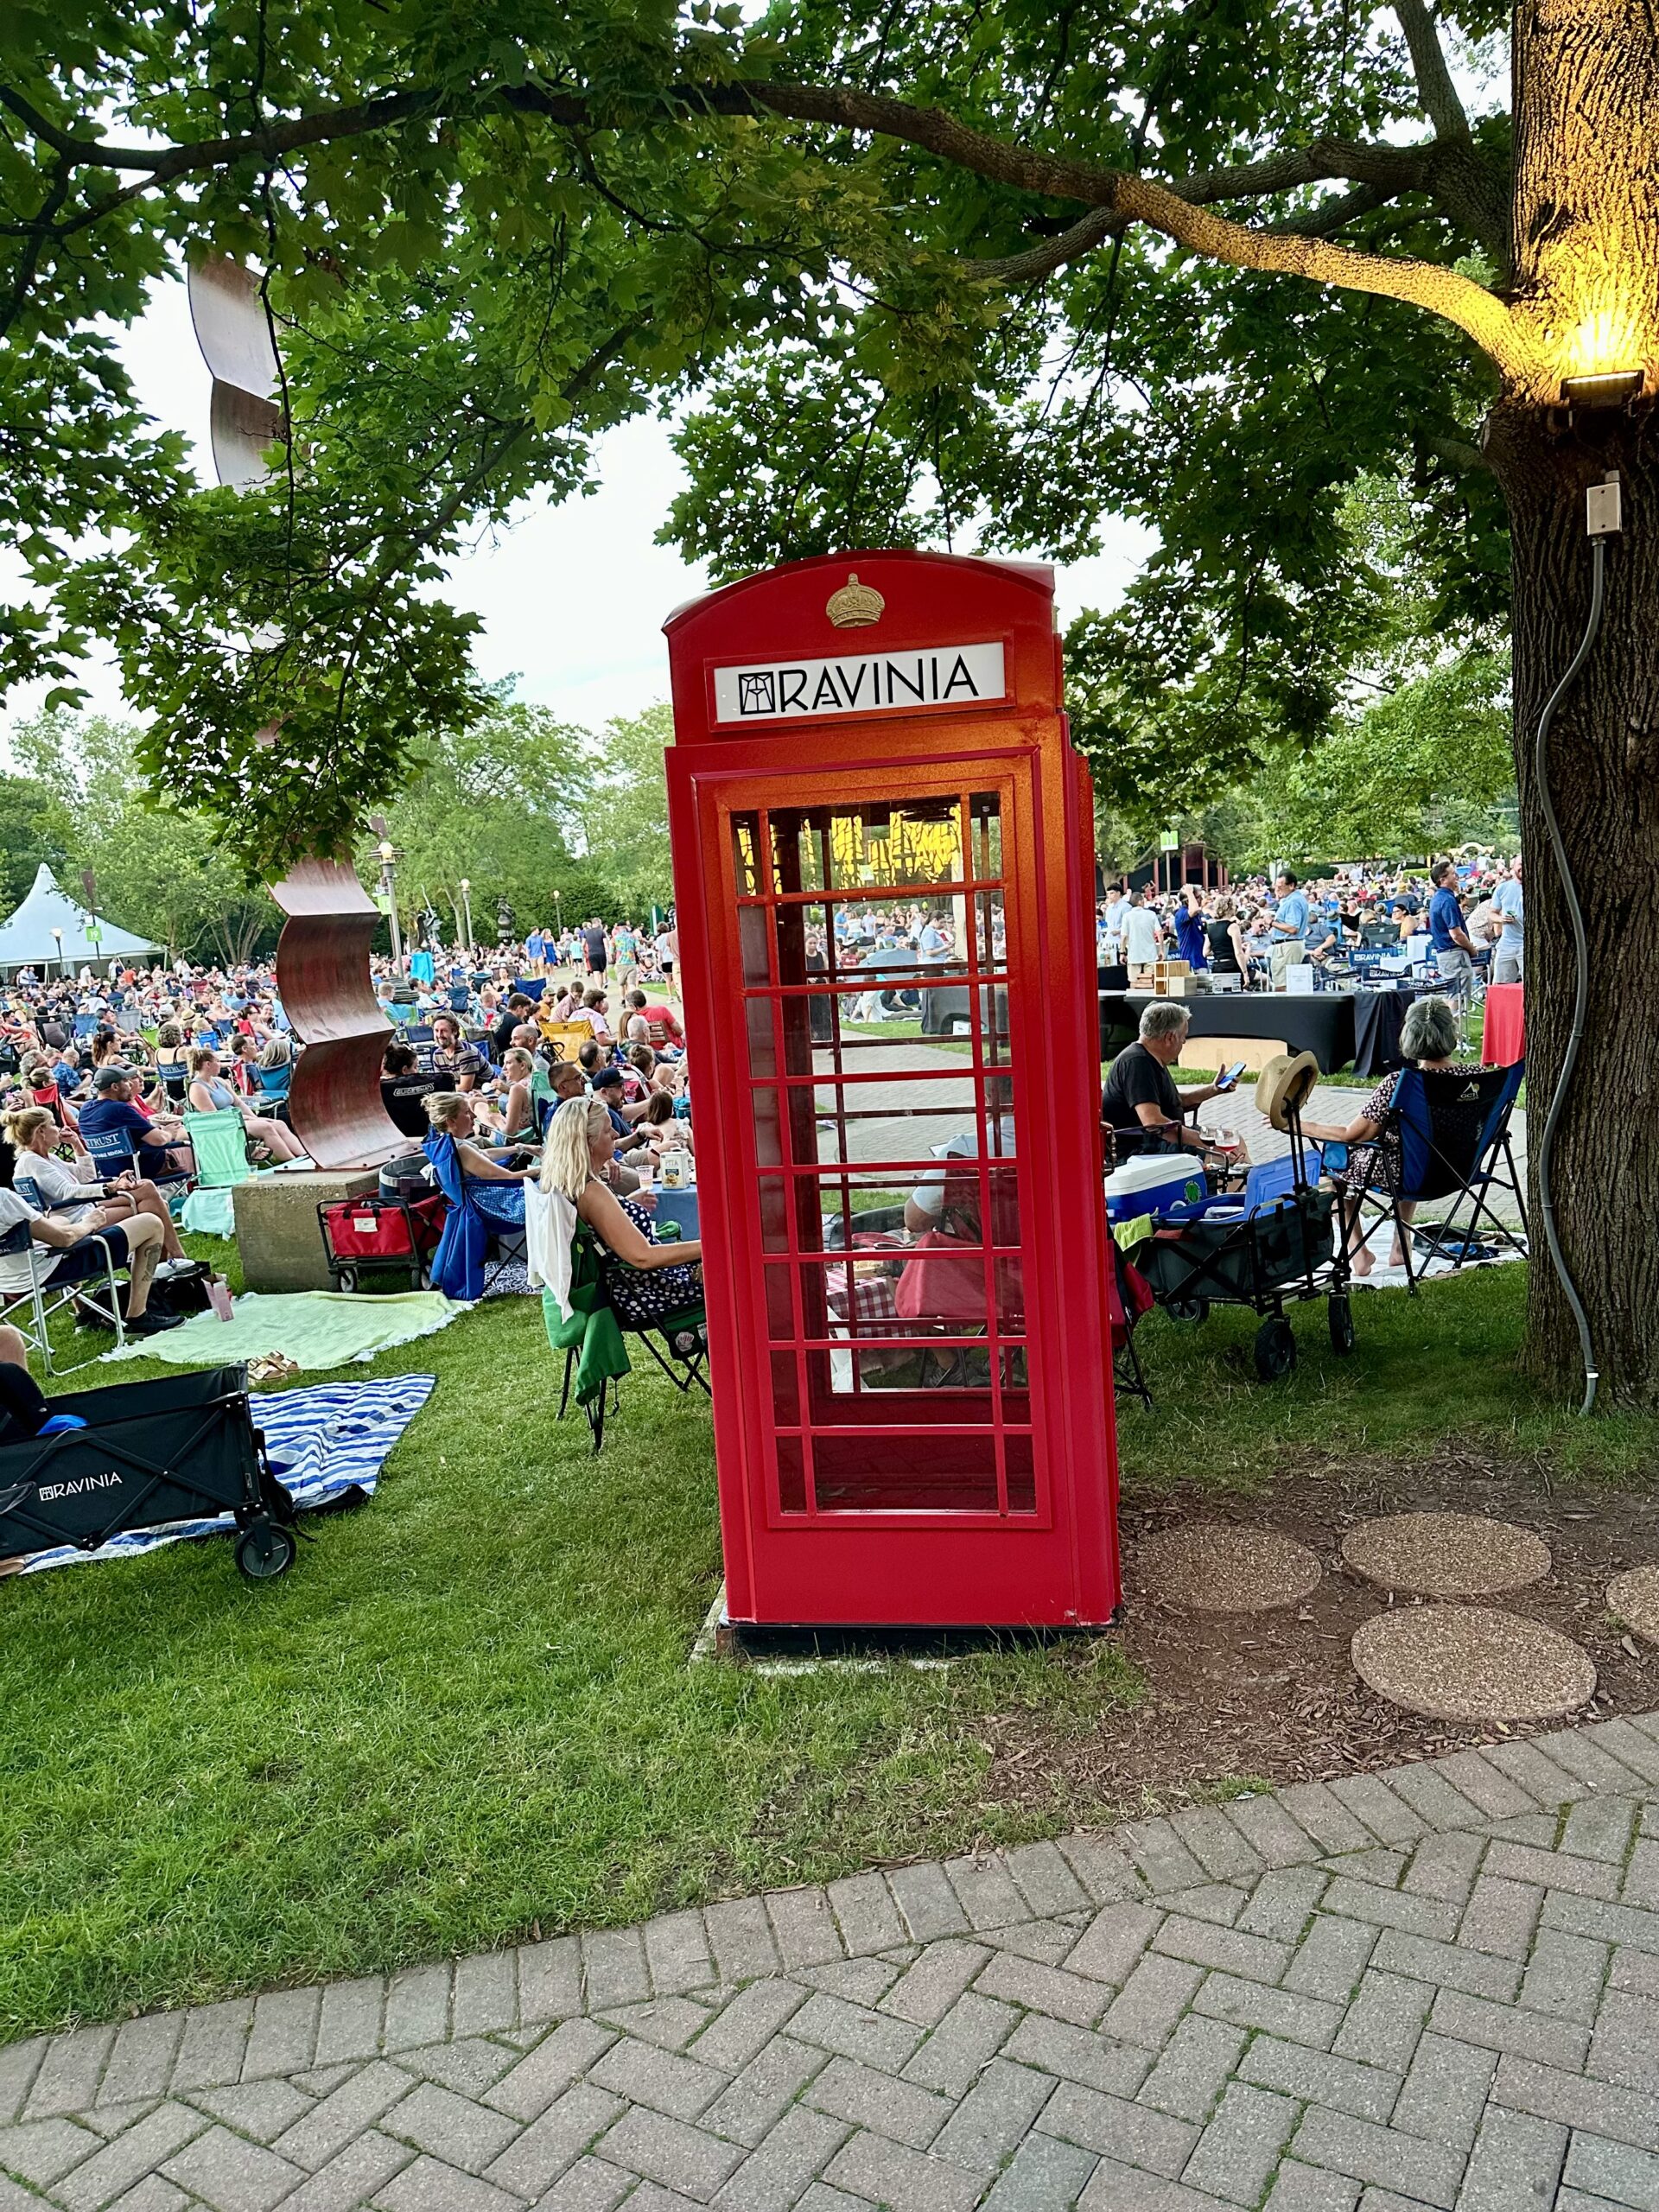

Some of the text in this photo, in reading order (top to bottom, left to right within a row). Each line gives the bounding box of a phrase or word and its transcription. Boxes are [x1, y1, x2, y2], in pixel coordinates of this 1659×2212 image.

[779, 653, 979, 712] RAVINIA
[90, 930, 99, 938] 19
[53, 1471, 123, 1498] RAVINIA
